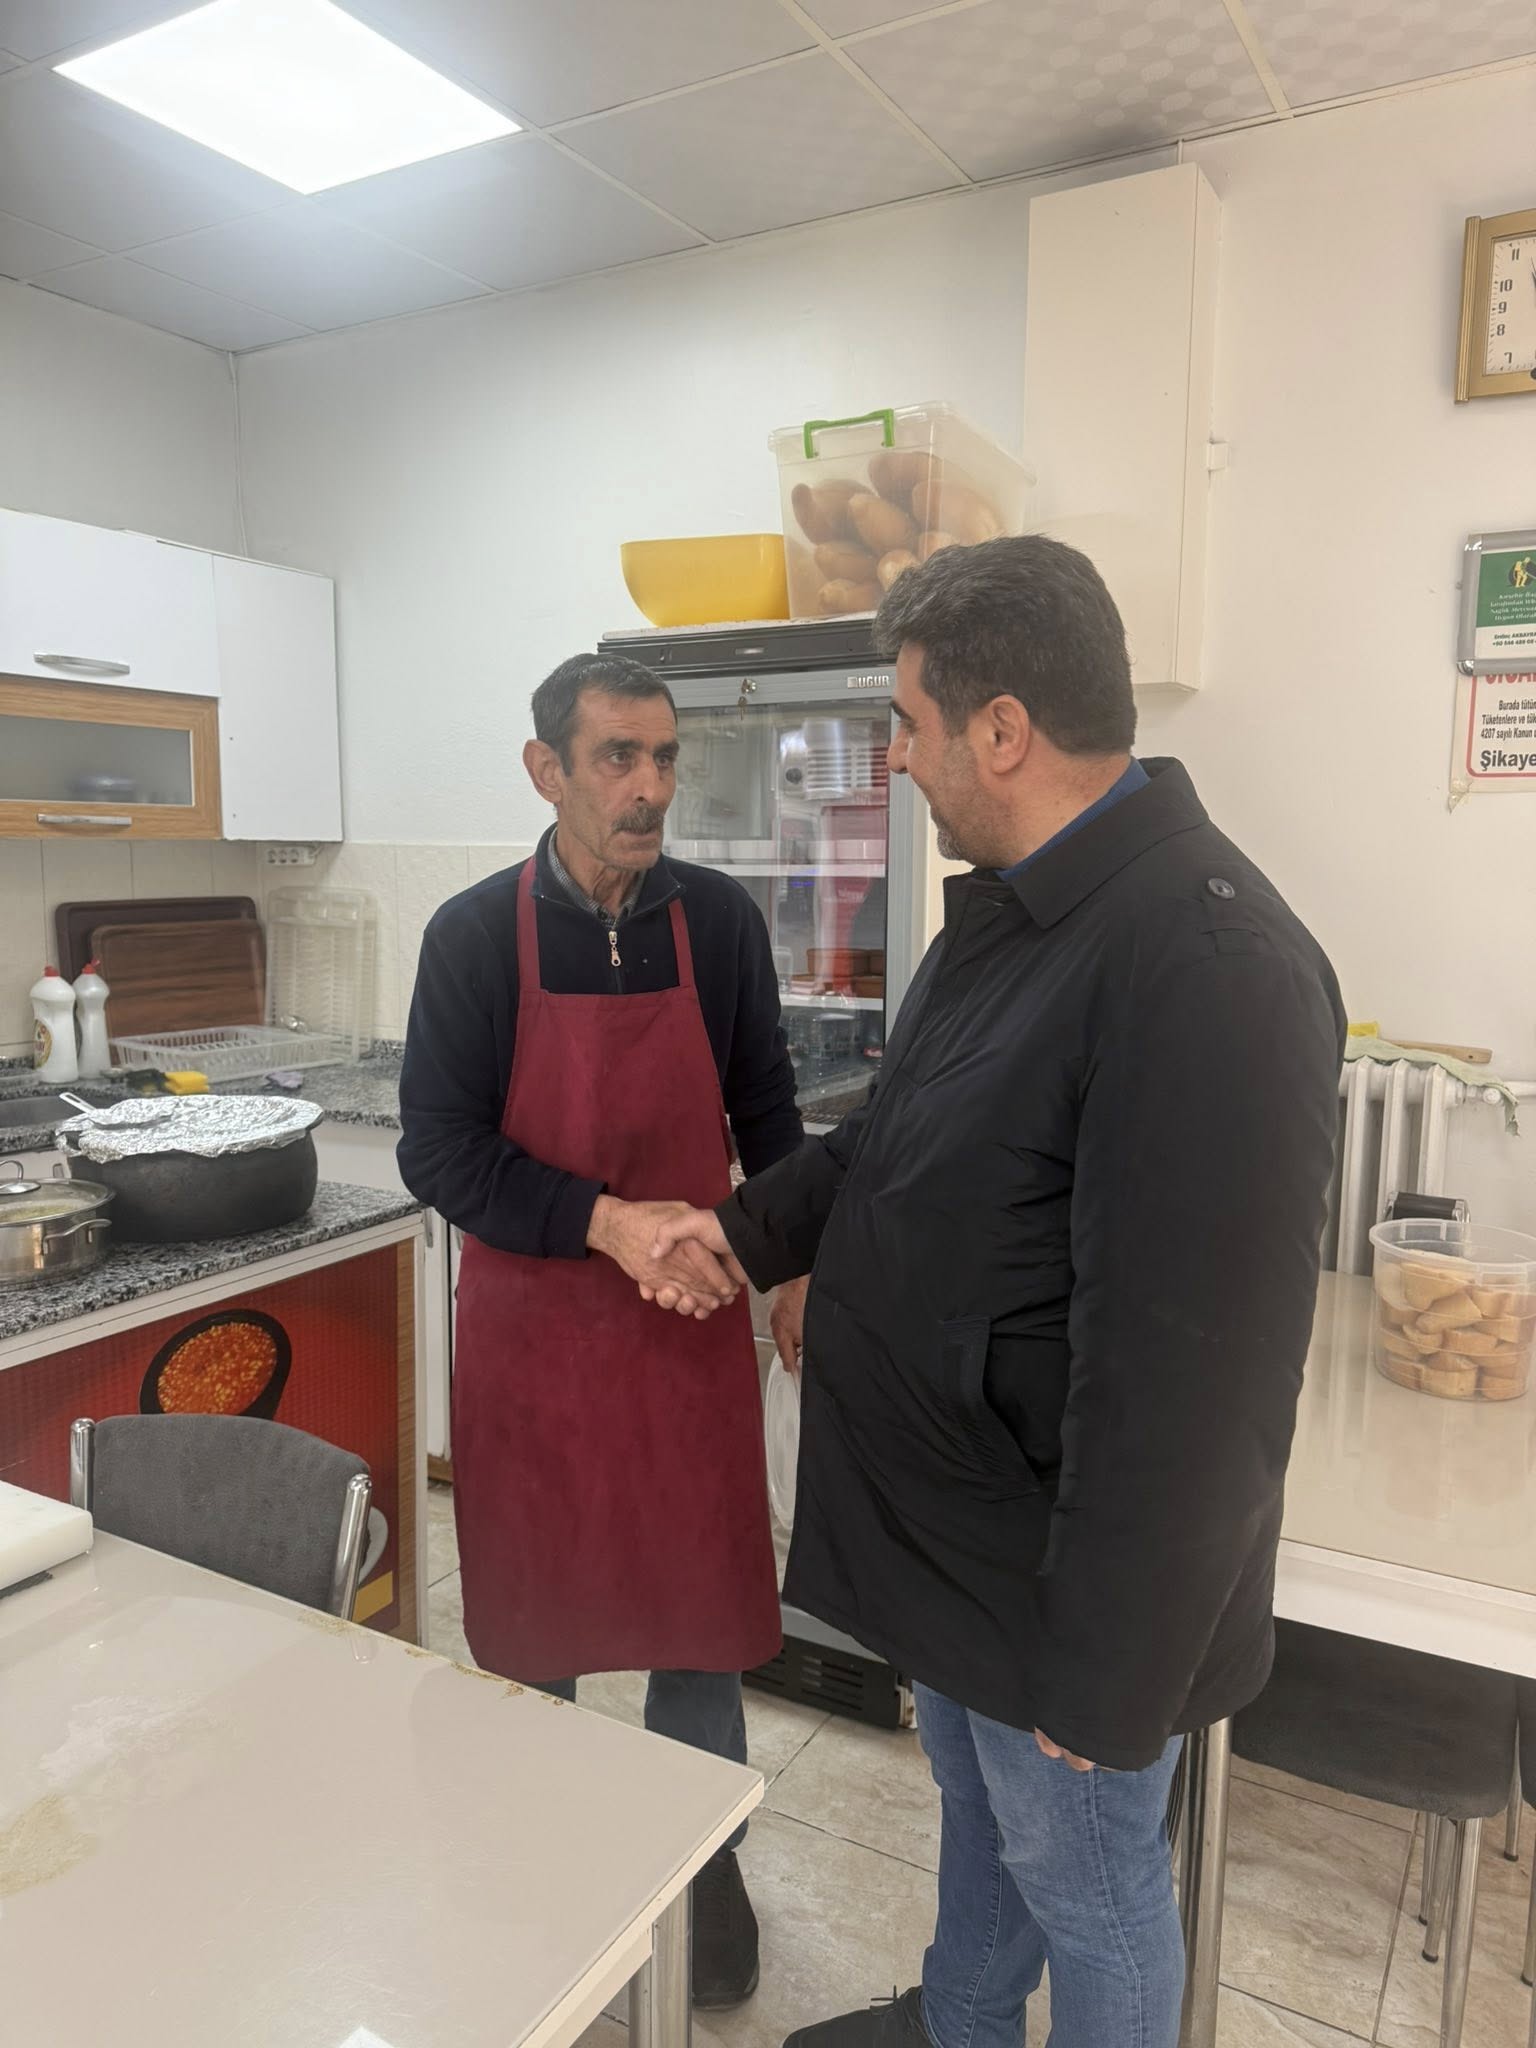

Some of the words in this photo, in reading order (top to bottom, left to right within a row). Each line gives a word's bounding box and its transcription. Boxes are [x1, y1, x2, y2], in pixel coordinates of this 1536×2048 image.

[1511, 248, 1520, 261] 11
[1499, 279, 1513, 292] 10
[1498, 301, 1507, 314] 9
[1496, 324, 1506, 336] 8
[1504, 352, 1513, 364] 7
[1498, 699, 1520, 711] Burada
[1518, 716, 1525, 724] ve
[1480, 727, 1495, 739] 4207
[1513, 728, 1533, 738] Kanun
[1480, 750, 1536, 771] Şikaye
